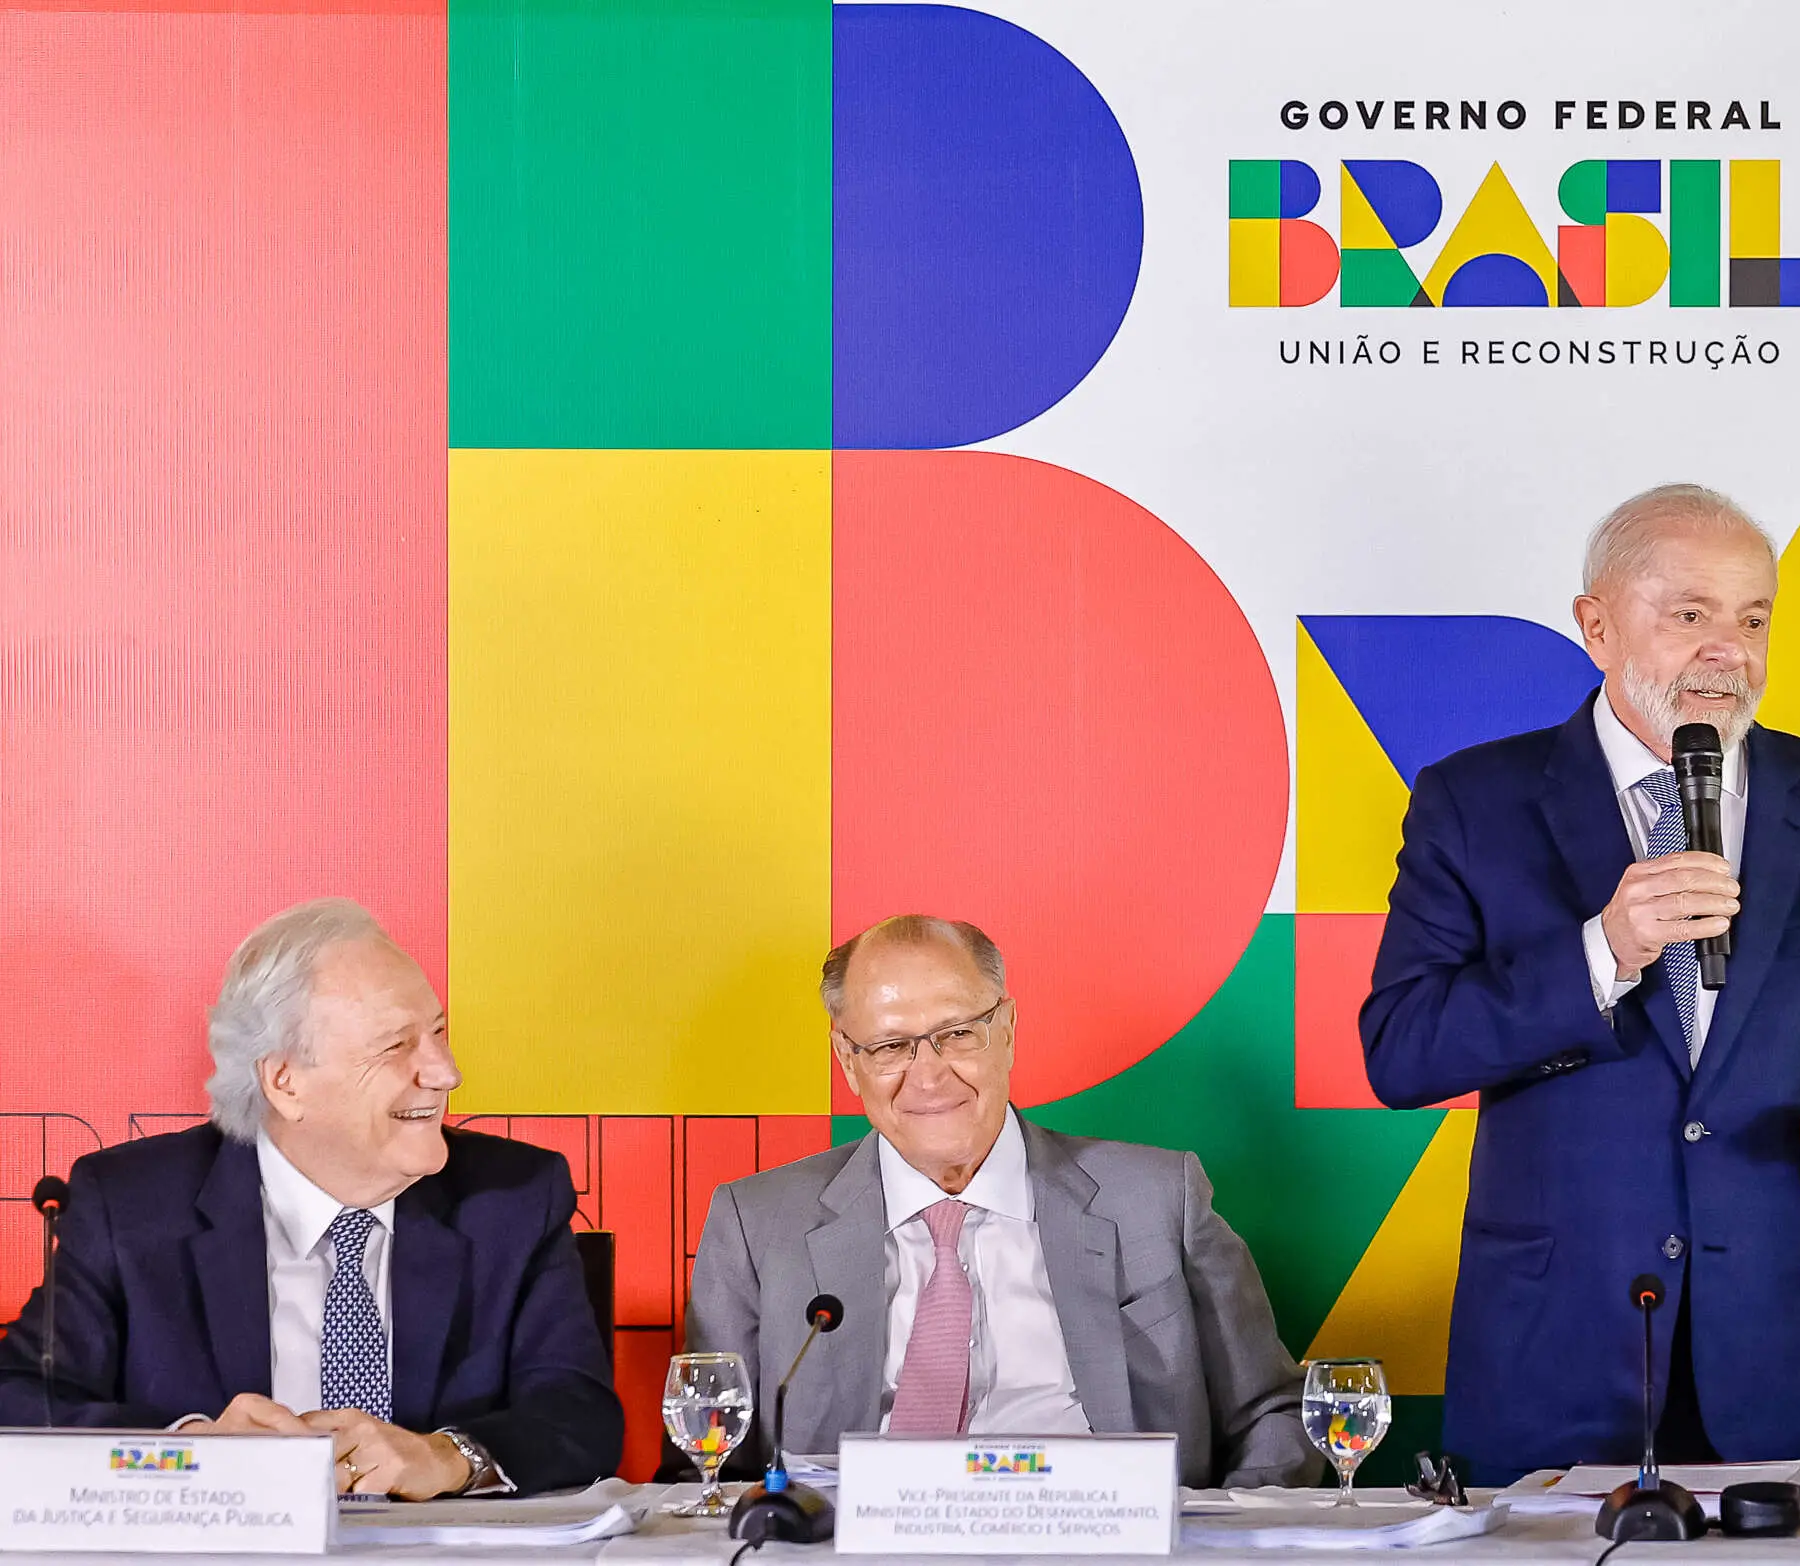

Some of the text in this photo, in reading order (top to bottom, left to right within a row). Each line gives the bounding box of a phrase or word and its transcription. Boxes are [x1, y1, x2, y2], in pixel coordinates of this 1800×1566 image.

[1281, 100, 1782, 130] GOVERNO FEDERAL
[1280, 335, 1781, 370] UNIÃO E RECONSTRUÇÃO
[180, 1487, 246, 1505] ESTADO
